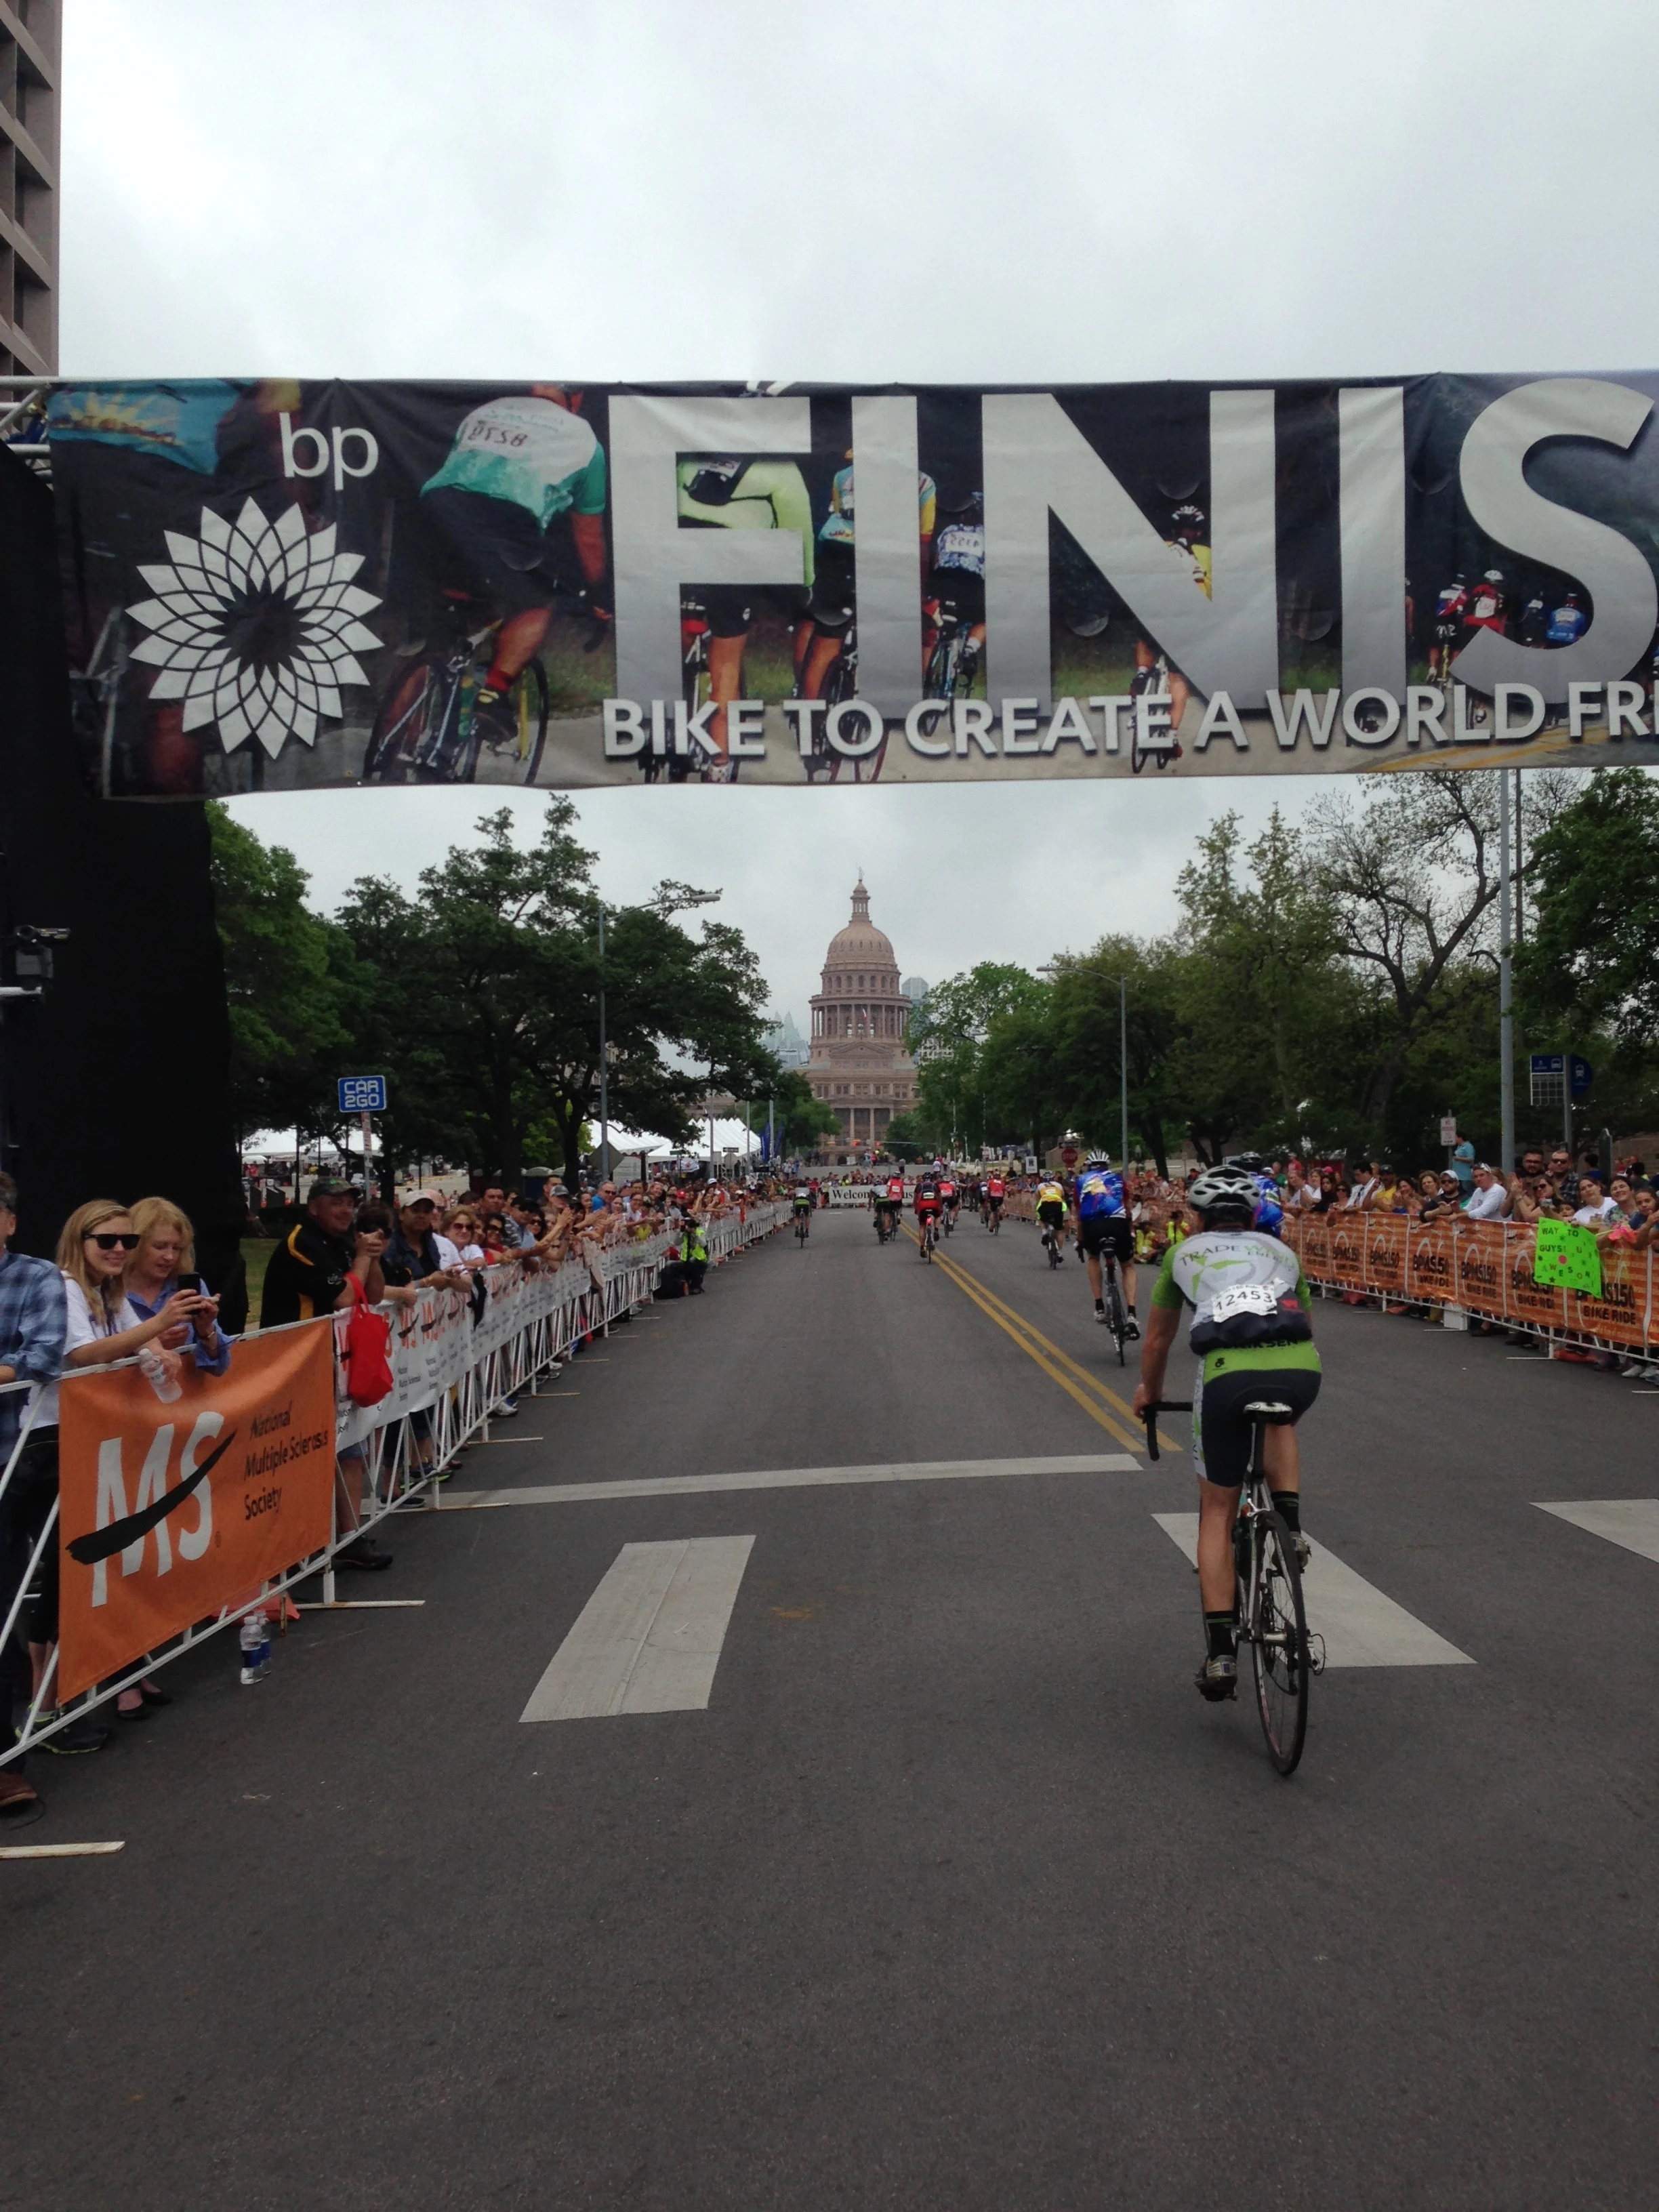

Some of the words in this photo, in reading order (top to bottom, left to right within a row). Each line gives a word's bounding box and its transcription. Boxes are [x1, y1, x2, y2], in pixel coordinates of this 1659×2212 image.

[279, 412, 378, 489] bp
[609, 377, 1658, 719] FINIS
[604, 699, 766, 757] BIKE
[785, 697, 885, 756] TO
[905, 695, 1173, 755] CREATE
[1194, 691, 1248, 748] A
[1266, 682, 1547, 747] WORLD
[1570, 680, 1659, 738] FR
[345, 1094, 380, 1108] 2GO
[832, 1189, 870, 1199] Welcom
[1568, 1229, 1579, 1237] TO
[1216, 1290, 1273, 1311] 12453
[1584, 1305, 1610, 1320] BIKE
[1612, 1309, 1636, 1326] RIDE
[251, 1401, 292, 1438] National
[245, 1438, 288, 1479] Multiple
[92, 1411, 225, 1607] MS
[244, 1486, 282, 1520] Society
